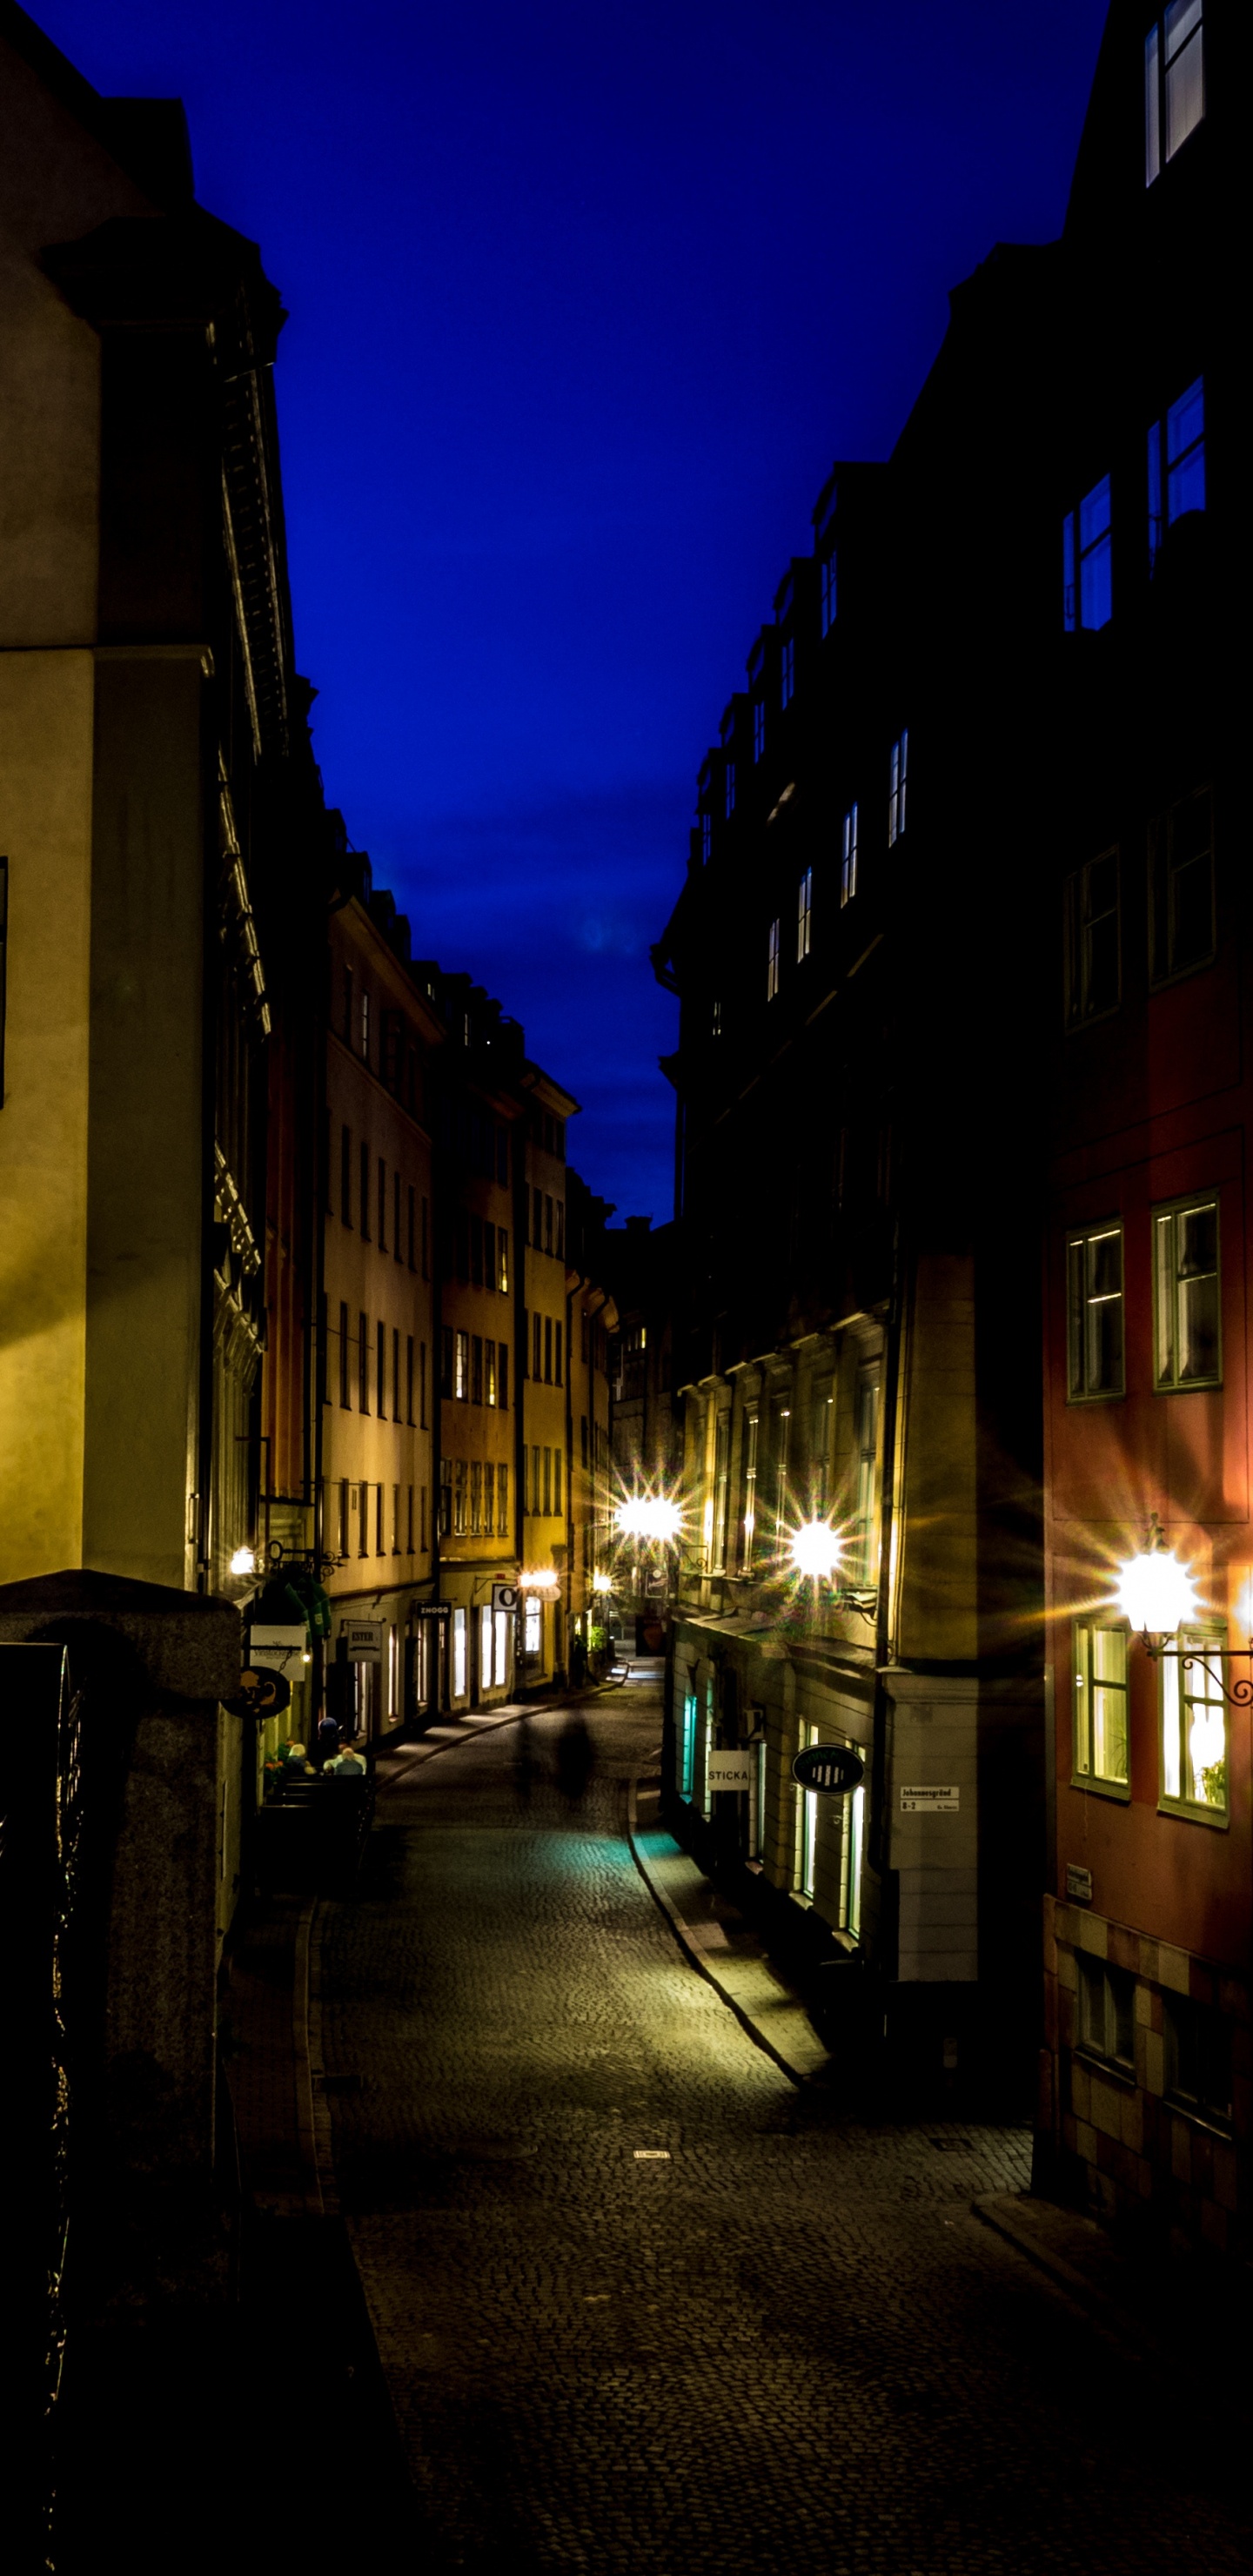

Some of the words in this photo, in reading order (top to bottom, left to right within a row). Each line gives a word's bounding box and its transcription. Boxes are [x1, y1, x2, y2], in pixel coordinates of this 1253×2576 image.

[352, 1632, 373, 1641] ESTER
[708, 1770, 748, 1781] STICKA
[902, 1788, 951, 1799] Johannesgränd
